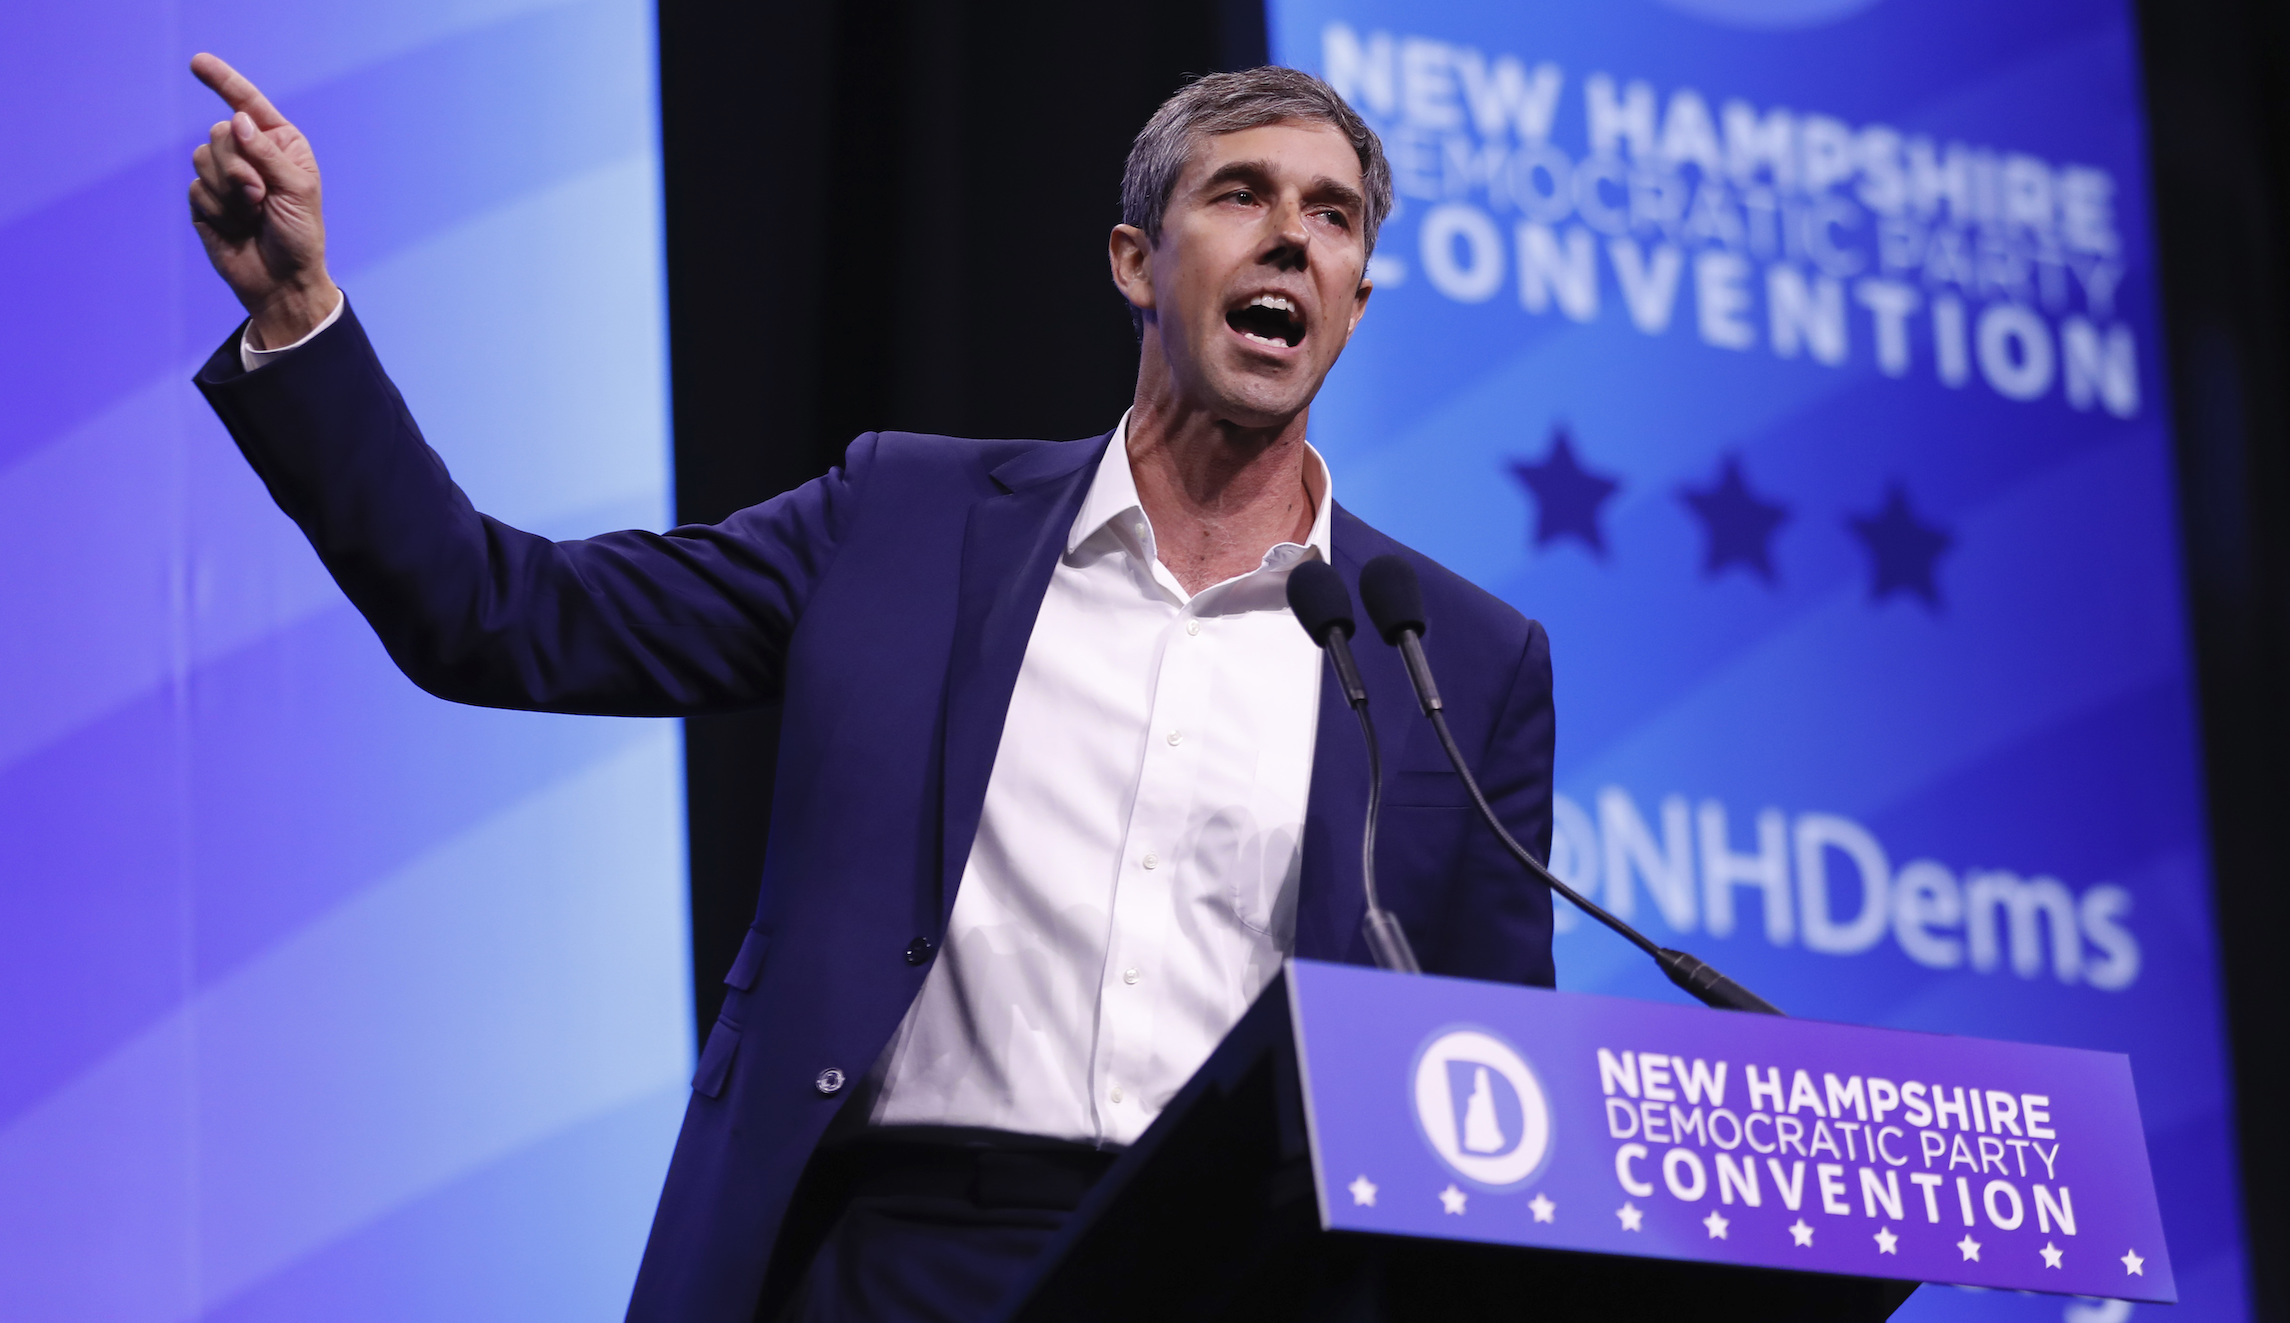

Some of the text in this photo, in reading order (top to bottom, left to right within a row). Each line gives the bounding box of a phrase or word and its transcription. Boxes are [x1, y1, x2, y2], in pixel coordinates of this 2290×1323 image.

[1322, 22, 2117, 262] NEW HAMPSHIRE
[1378, 120, 1866, 282] EMOCRATIC
[1366, 200, 2141, 420] ONVENTION
[1597, 1047, 2057, 1141] NEW HAMPSHIRE
[1604, 1096, 2060, 1181] DEMOCRATIC PARTY
[1615, 1142, 2077, 1237] CONVENTION
